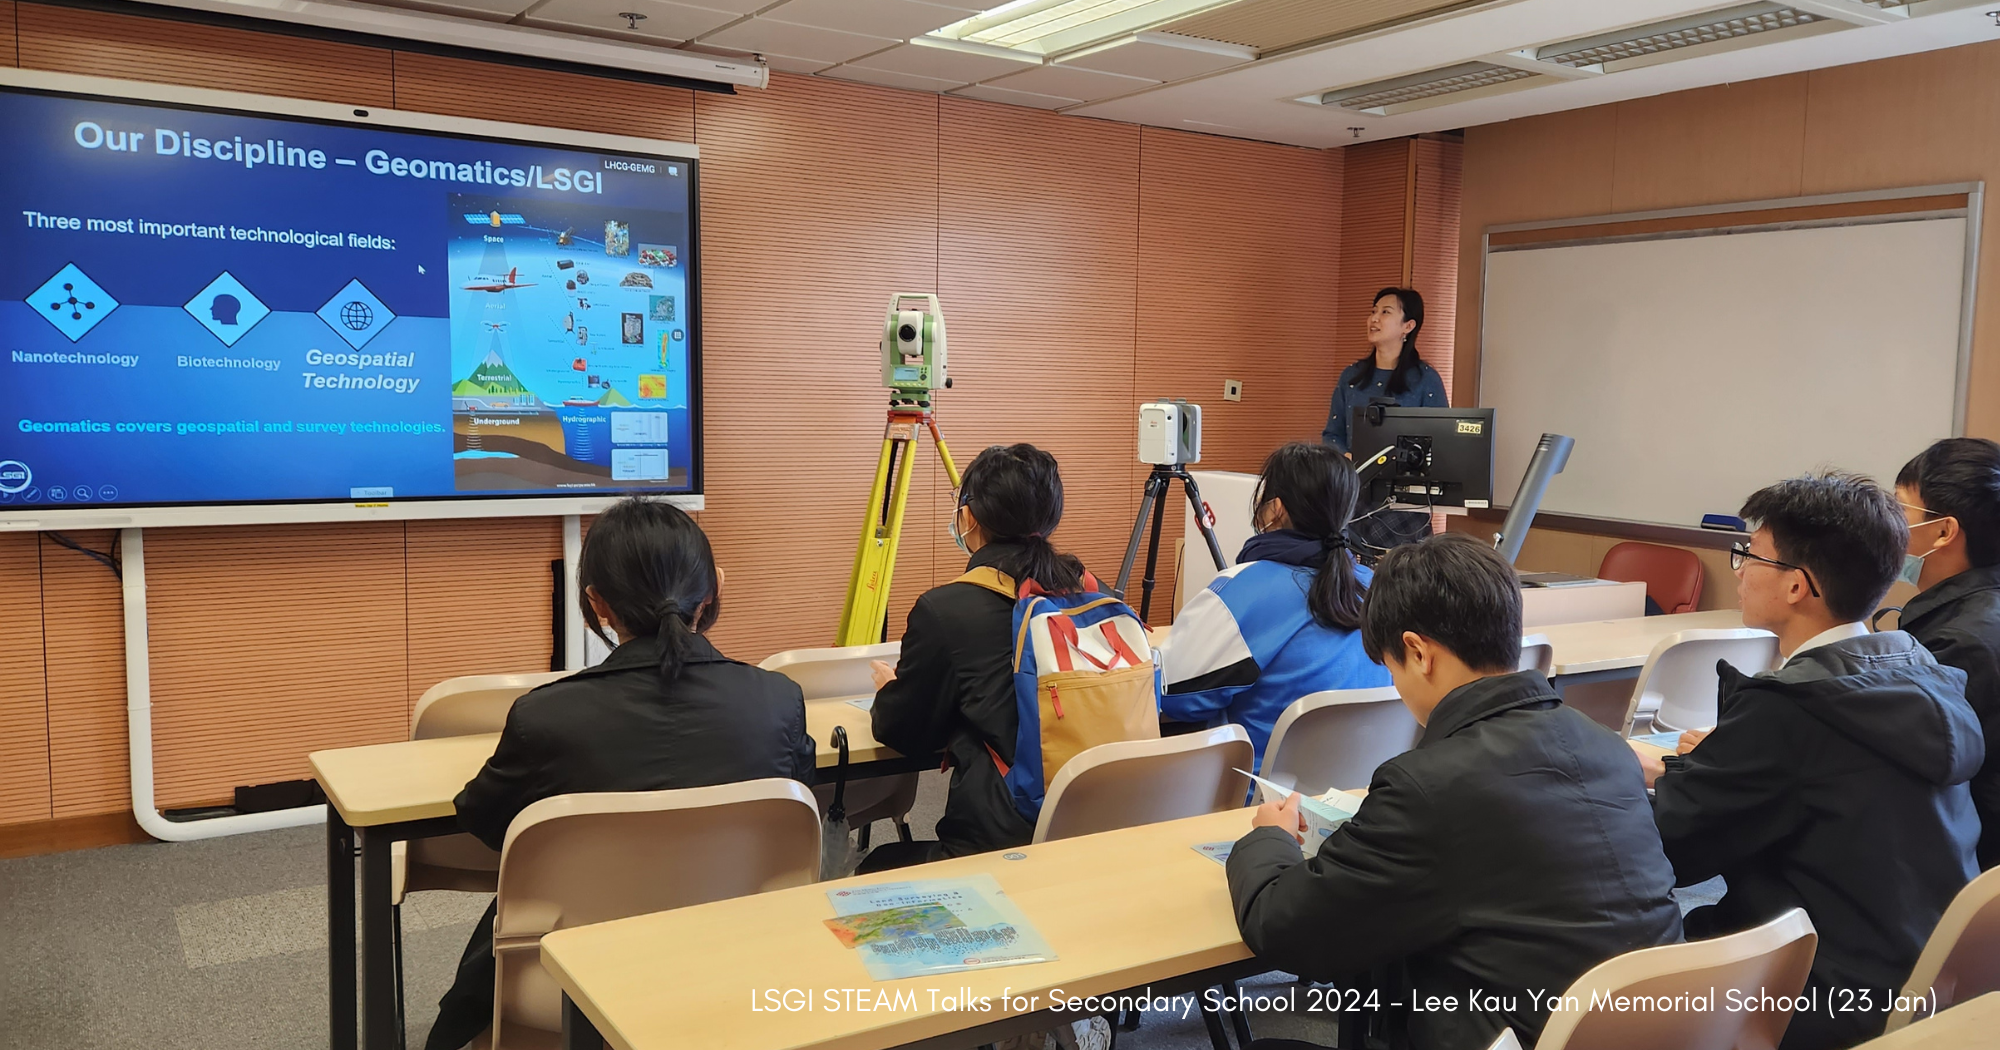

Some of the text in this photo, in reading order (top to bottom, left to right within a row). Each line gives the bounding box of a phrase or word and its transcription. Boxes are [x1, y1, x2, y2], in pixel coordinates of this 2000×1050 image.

[74, 121, 145, 153] Our
[154, 127, 327, 169] Discipline
[364, 149, 603, 194] Geomatics/LSGI
[604, 160, 656, 174] LHCG-GEMG
[22, 210, 397, 250] Three most important technological fields:
[483, 234, 504, 244] Space
[485, 302, 506, 310] Aerial
[11, 349, 140, 368] Nanotechnology
[177, 354, 282, 372] Biotechnology
[305, 348, 416, 370] Geospatial
[302, 372, 421, 394] Technology
[476, 373, 513, 383] Terrestrial
[473, 417, 520, 427] Underground
[562, 414, 607, 425] Hydrographic
[18, 419, 447, 436] Geomatics covers geospatial and survey technologies.
[1458, 424, 1481, 434] 3426
